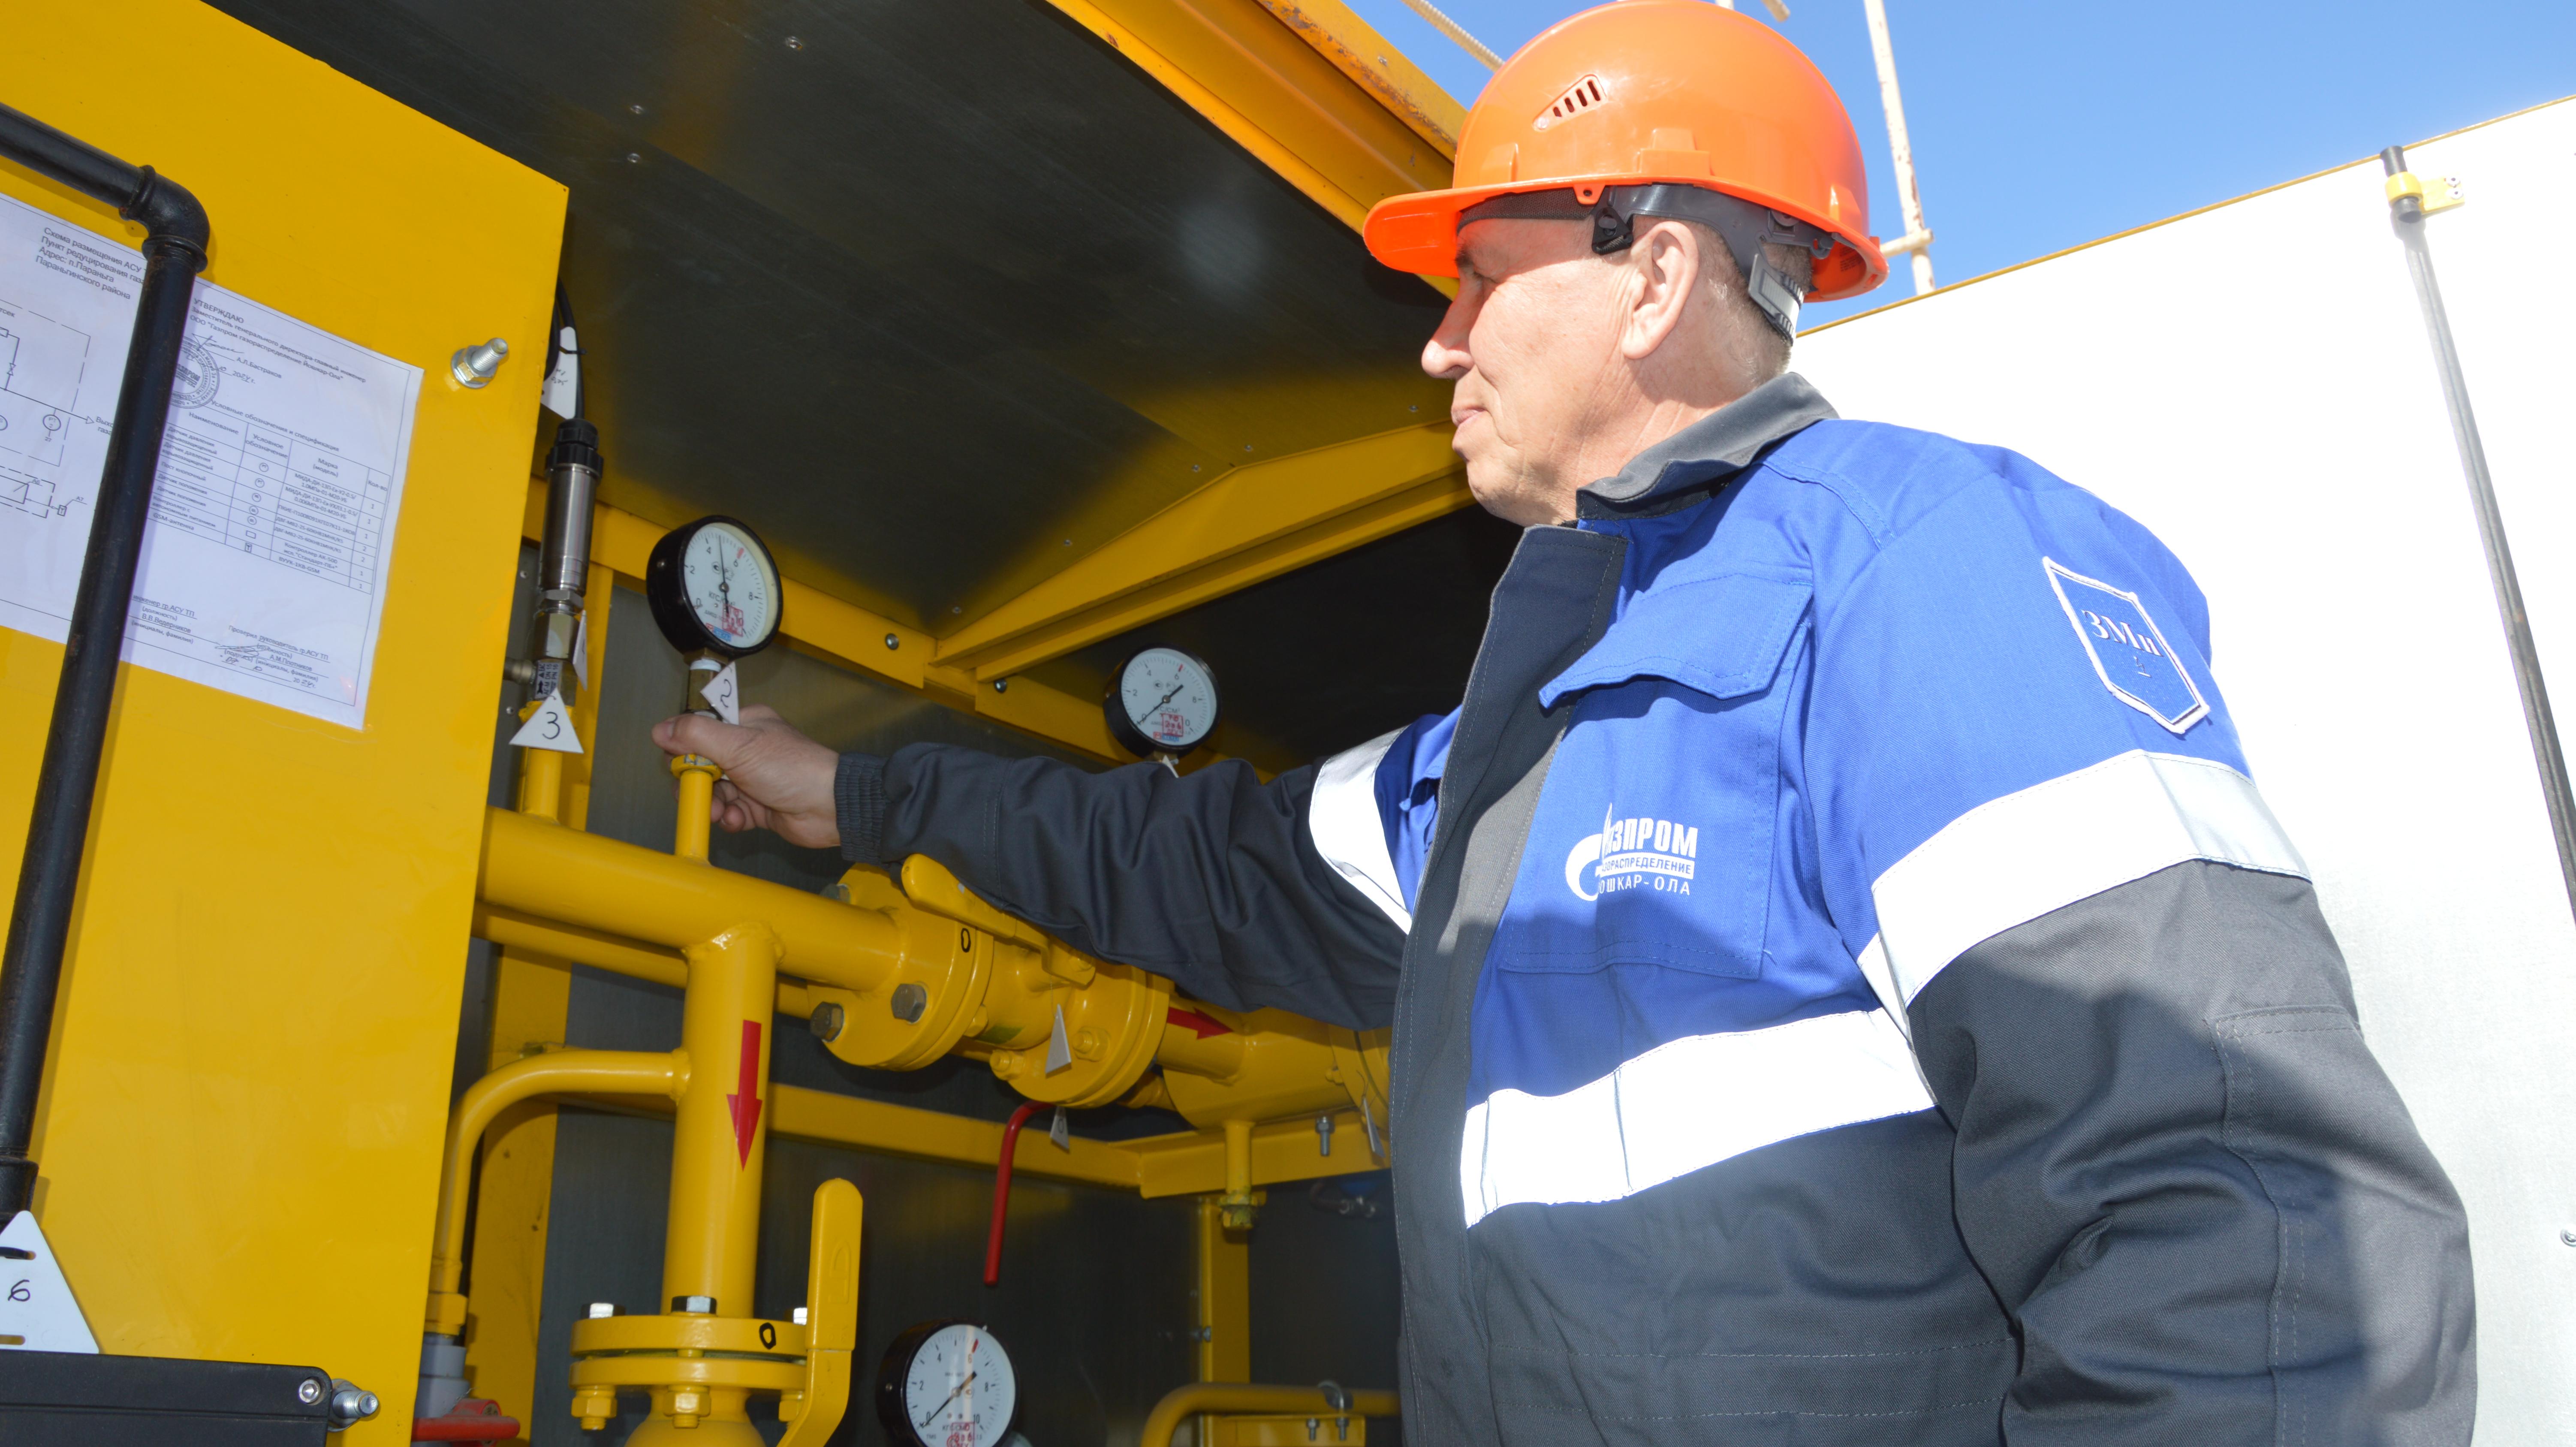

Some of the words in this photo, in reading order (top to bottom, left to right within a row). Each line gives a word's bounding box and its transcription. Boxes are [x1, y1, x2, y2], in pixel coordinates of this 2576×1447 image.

[42, 236, 65, 251] Пункт
[66, 248, 128, 278] редуцирования
[44, 227, 70, 243] Схема
[72, 241, 123, 265] размещения
[124, 261, 142, 273] АСУ
[39, 247, 66, 263] Адрес:
[69, 260, 114, 282] п.Параньга
[36, 256, 100, 287] Параньгинского
[102, 283, 131, 299] района
[0, 307, 15, 318] тсек
[194, 298, 244, 323] УТВЕРЖДАЮ
[190, 315, 206, 326] ООО
[239, 335, 302, 365] газораспределение
[192, 306, 233, 327] Заместитель
[235, 325, 278, 347] генерального
[340, 369, 366, 383] инженер
[189, 412, 239, 435] Наименование
[211, 399, 243, 416] Условные
[245, 413, 288, 433] обозначения
[295, 432, 340, 452] спецификация
[168, 427, 188, 437] Датчик
[189, 434, 214, 447] давления
[253, 434, 284, 449] Условное
[164, 441, 184, 453] Датчик
[184, 451, 211, 462] давления
[246, 440, 289, 459] обозначение
[161, 461, 174, 470] Пост
[176, 468, 206, 481] кнопочный
[313, 464, 338, 478] (модель)
[318, 458, 338, 469] Марка
[158, 473, 177, 485] Датчик
[178, 482, 208, 494] положения
[368, 480, 388, 491] Кол-во
[153, 495, 186, 511] Контроллер
[157, 485, 176, 496] Датчик
[177, 494, 206, 506] положения
[152, 502, 188, 517] автономным
[189, 515, 216, 528] питанием
[153, 512, 194, 531] GSM-антенна
[285, 542, 317, 558] Контроллер
[690, 565, 695, 574] 2
[133, 594, 160, 607] инженер
[748, 591, 753, 600] 8
[142, 606, 178, 621] (должность)
[142, 613, 191, 633] В.В.Ведерников
[132, 620, 165, 636] (инициалы,
[166, 631, 194, 644] фамилия)
[229, 625, 257, 639] Проверил
[259, 636, 298, 651] руководитель
[256, 658, 289, 674] (инициалы,
[291, 669, 319, 682] фамилия)
[270, 654, 313, 672] А.М.Плотников
[720, 679, 732, 708] 2
[542, 711, 560, 739] 3
[8, 1279, 31, 1302] 6
[937, 1353, 941, 1363] 4
[968, 1354, 972, 1364] 6
[919, 1380, 924, 1391] 2
[984, 1382, 988, 1393] 8
